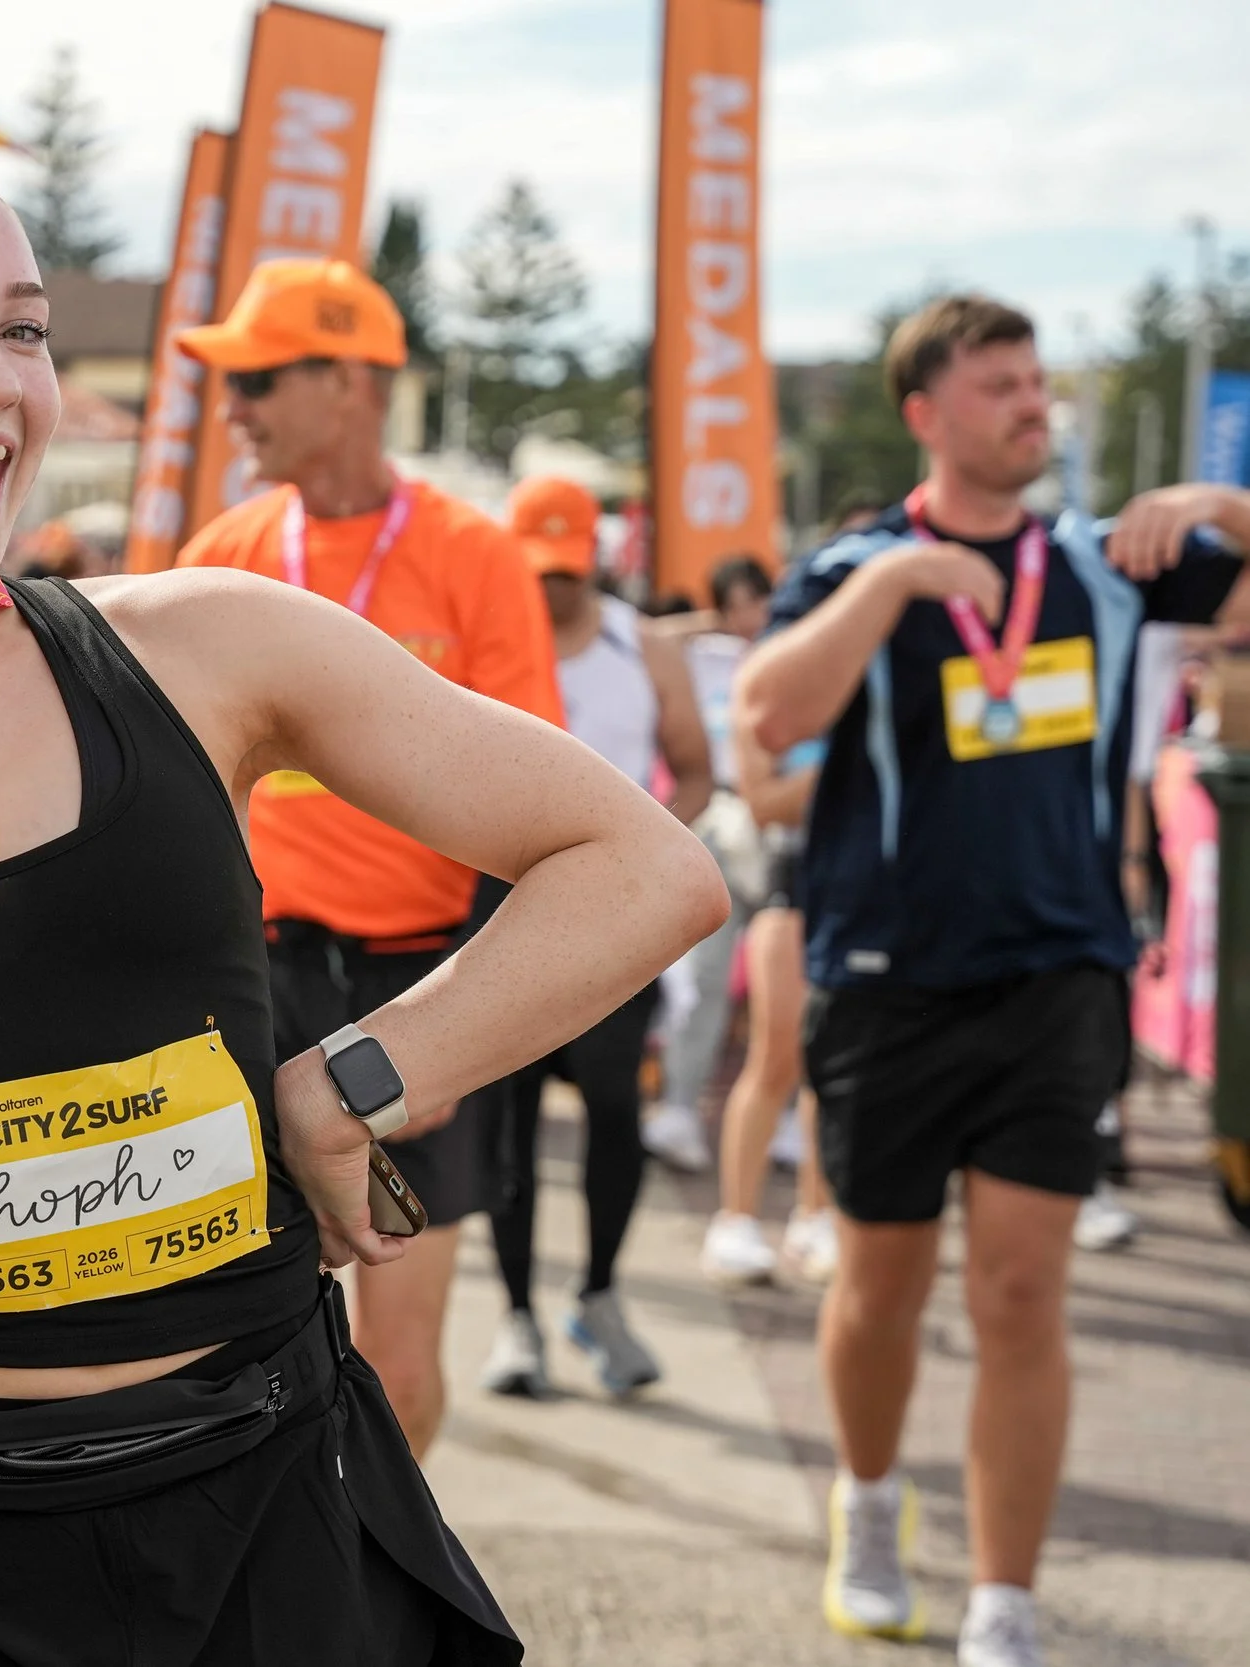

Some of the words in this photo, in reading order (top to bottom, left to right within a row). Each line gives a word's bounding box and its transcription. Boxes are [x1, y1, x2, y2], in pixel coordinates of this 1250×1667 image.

[682, 73, 751, 529] MEDALS
[144, 1207, 240, 1265] 75563
[73, 1262, 125, 1280] YELLOW
[77, 1247, 119, 1267] 2026
